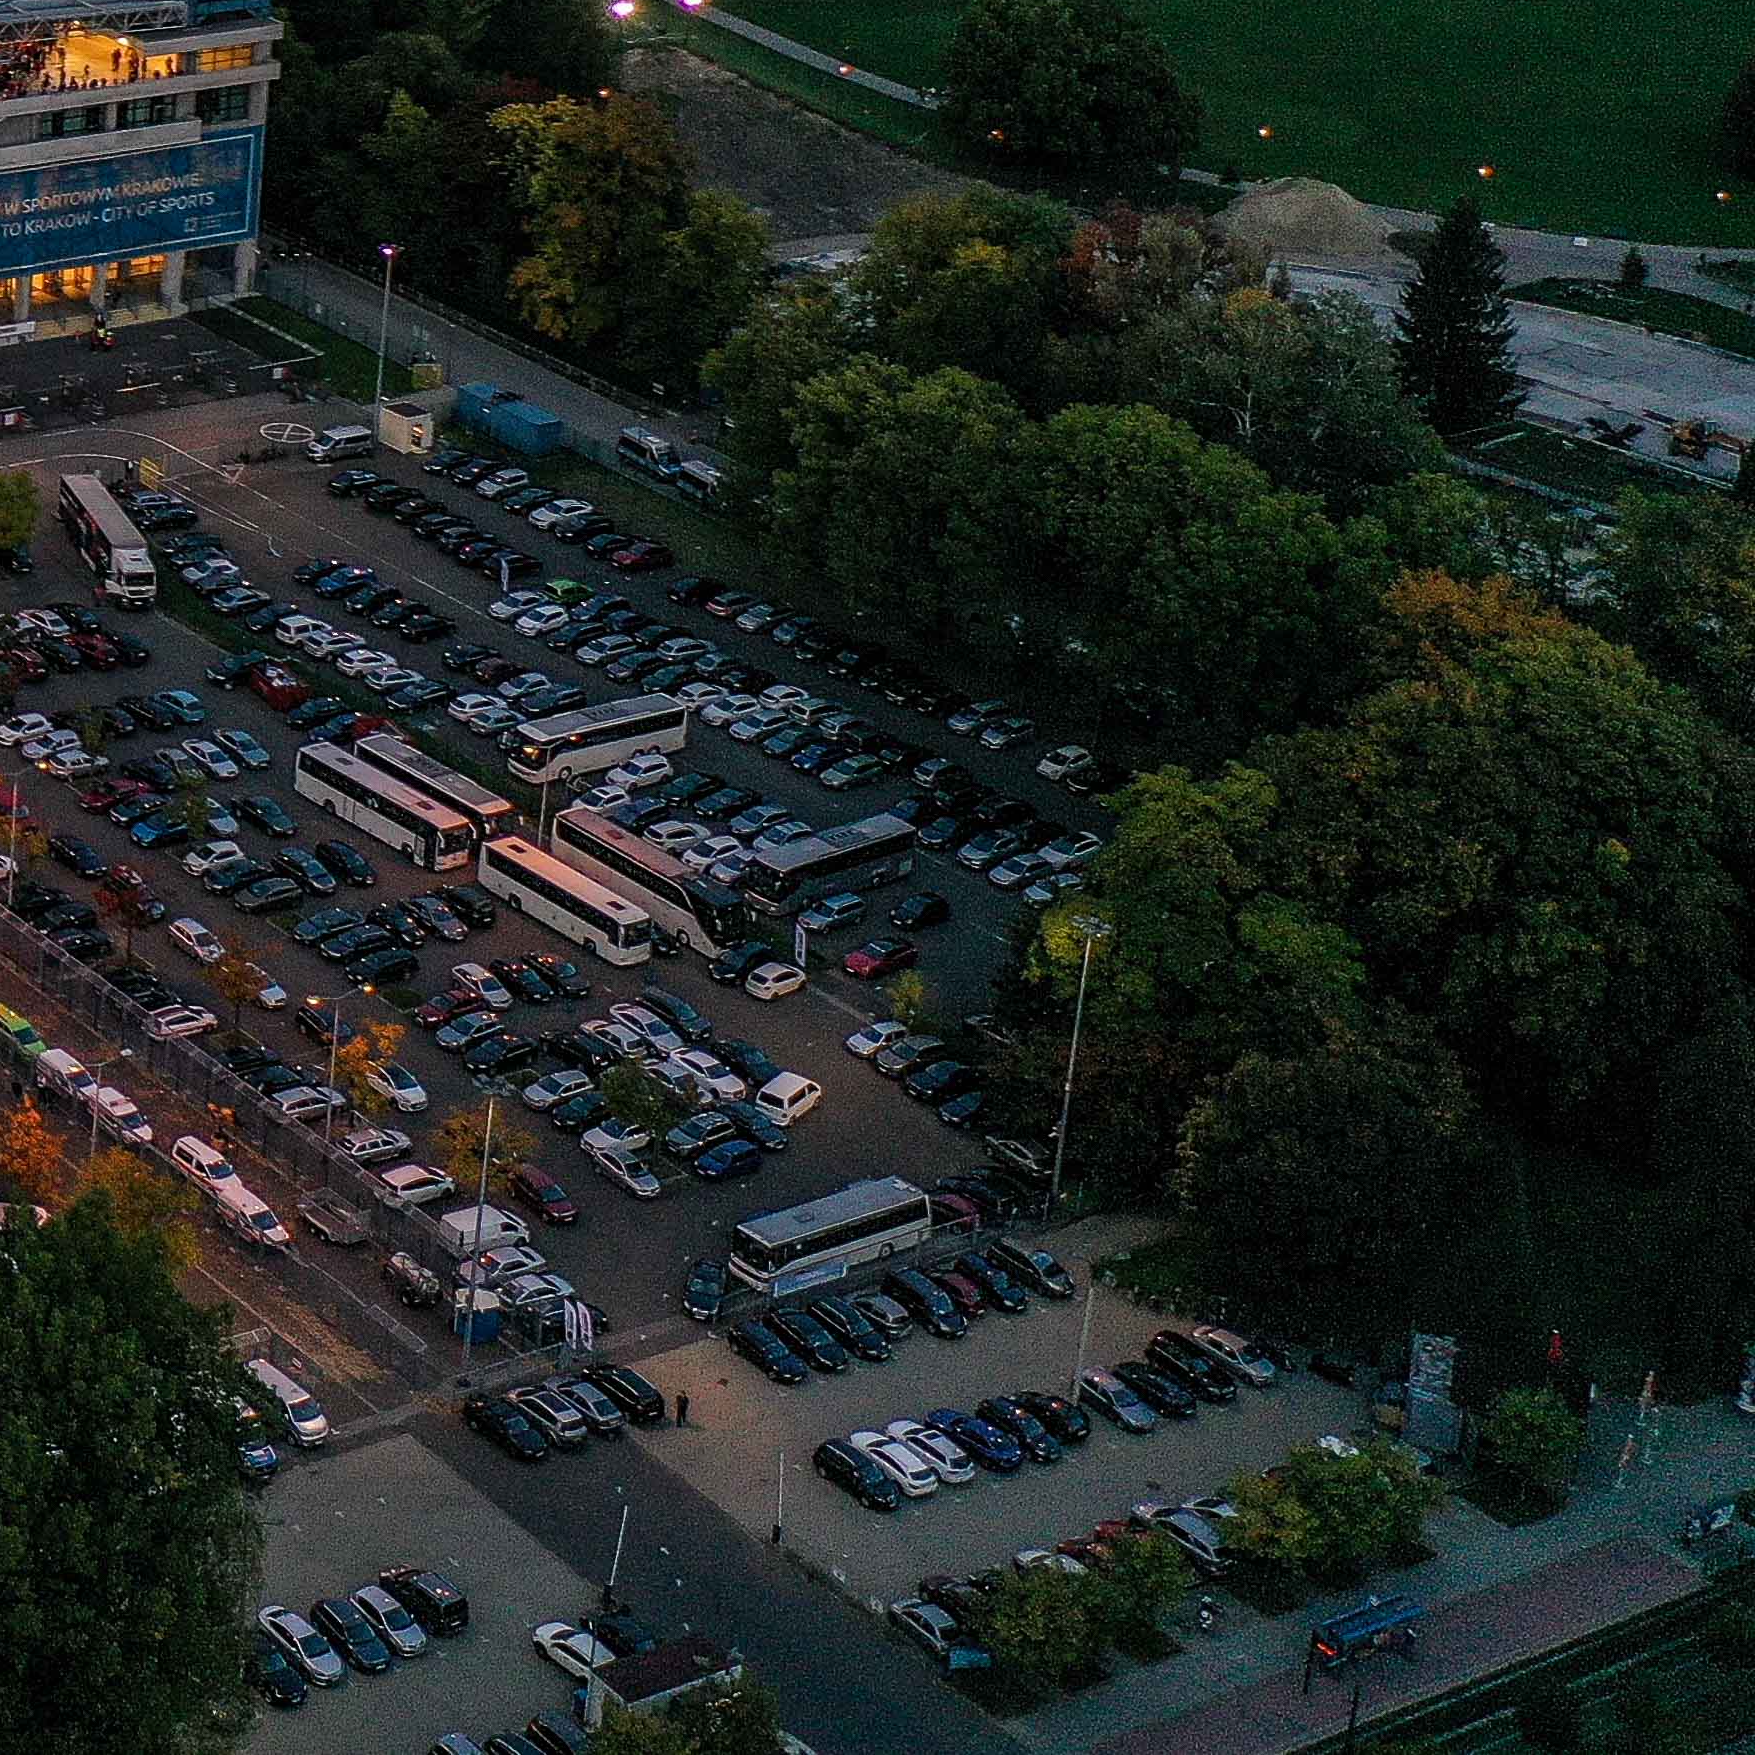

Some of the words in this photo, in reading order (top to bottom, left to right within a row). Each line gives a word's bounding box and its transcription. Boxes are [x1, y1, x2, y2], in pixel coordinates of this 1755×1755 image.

[3, 202, 20, 215] W
[22, 187, 120, 213] SPORTOWYM
[122, 173, 204, 197] KRAKOWIE
[3, 223, 20, 237] TO
[102, 207, 133, 223] CITY
[136, 202, 157, 217] OF
[159, 192, 216, 214] SPORTS
